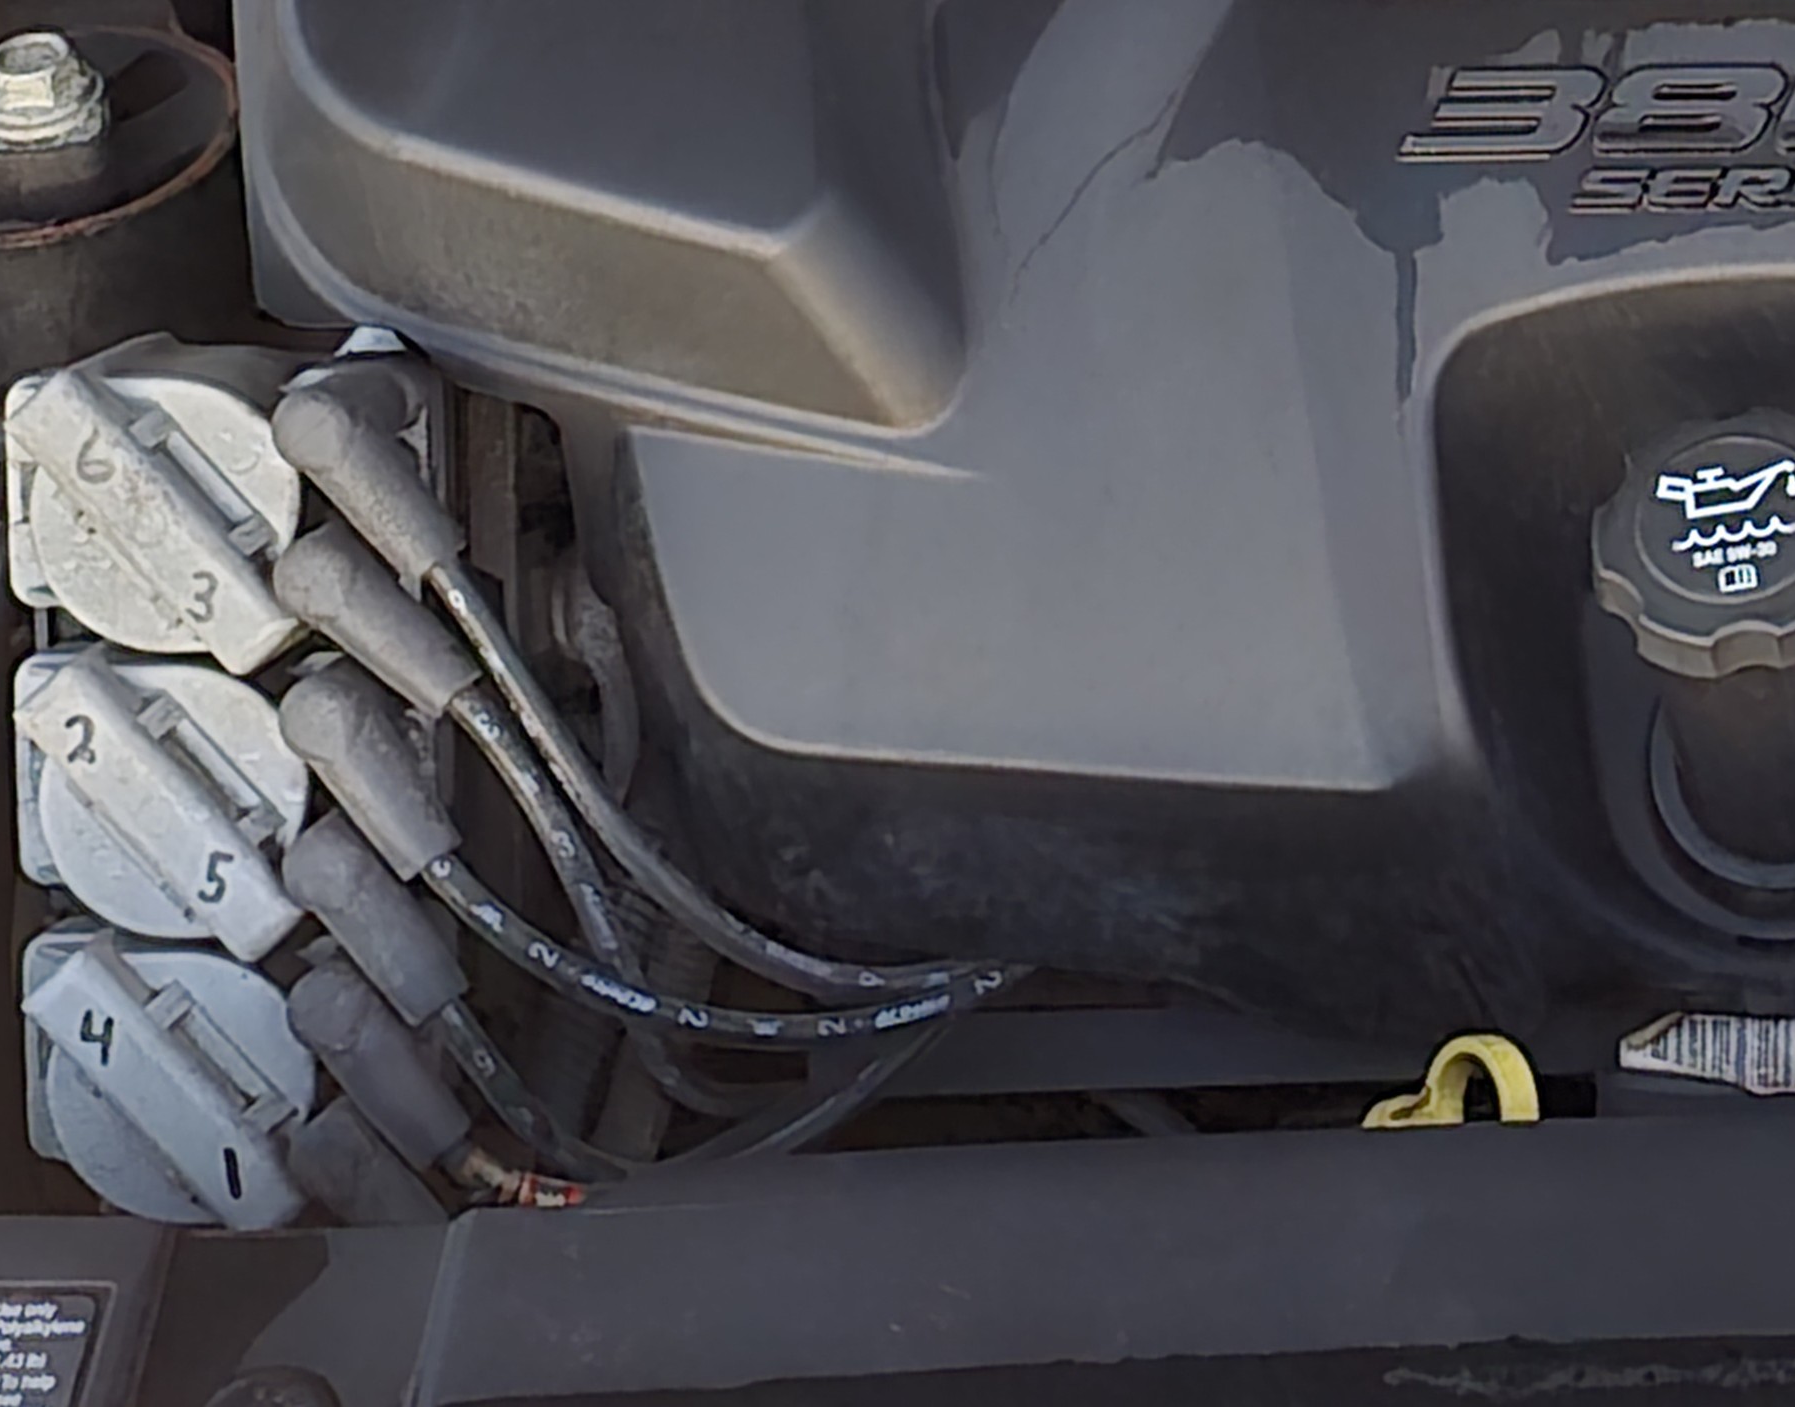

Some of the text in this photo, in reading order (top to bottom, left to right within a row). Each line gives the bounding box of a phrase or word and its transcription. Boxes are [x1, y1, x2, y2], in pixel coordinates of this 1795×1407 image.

[74, 425, 117, 485] 6
[1691, 546, 1725, 569] SAE
[185, 571, 220, 623] 3
[63, 713, 99, 764] 2
[197, 851, 234, 905] 5
[77, 1010, 117, 1066] 4
[223, 1146, 242, 1199] 1
